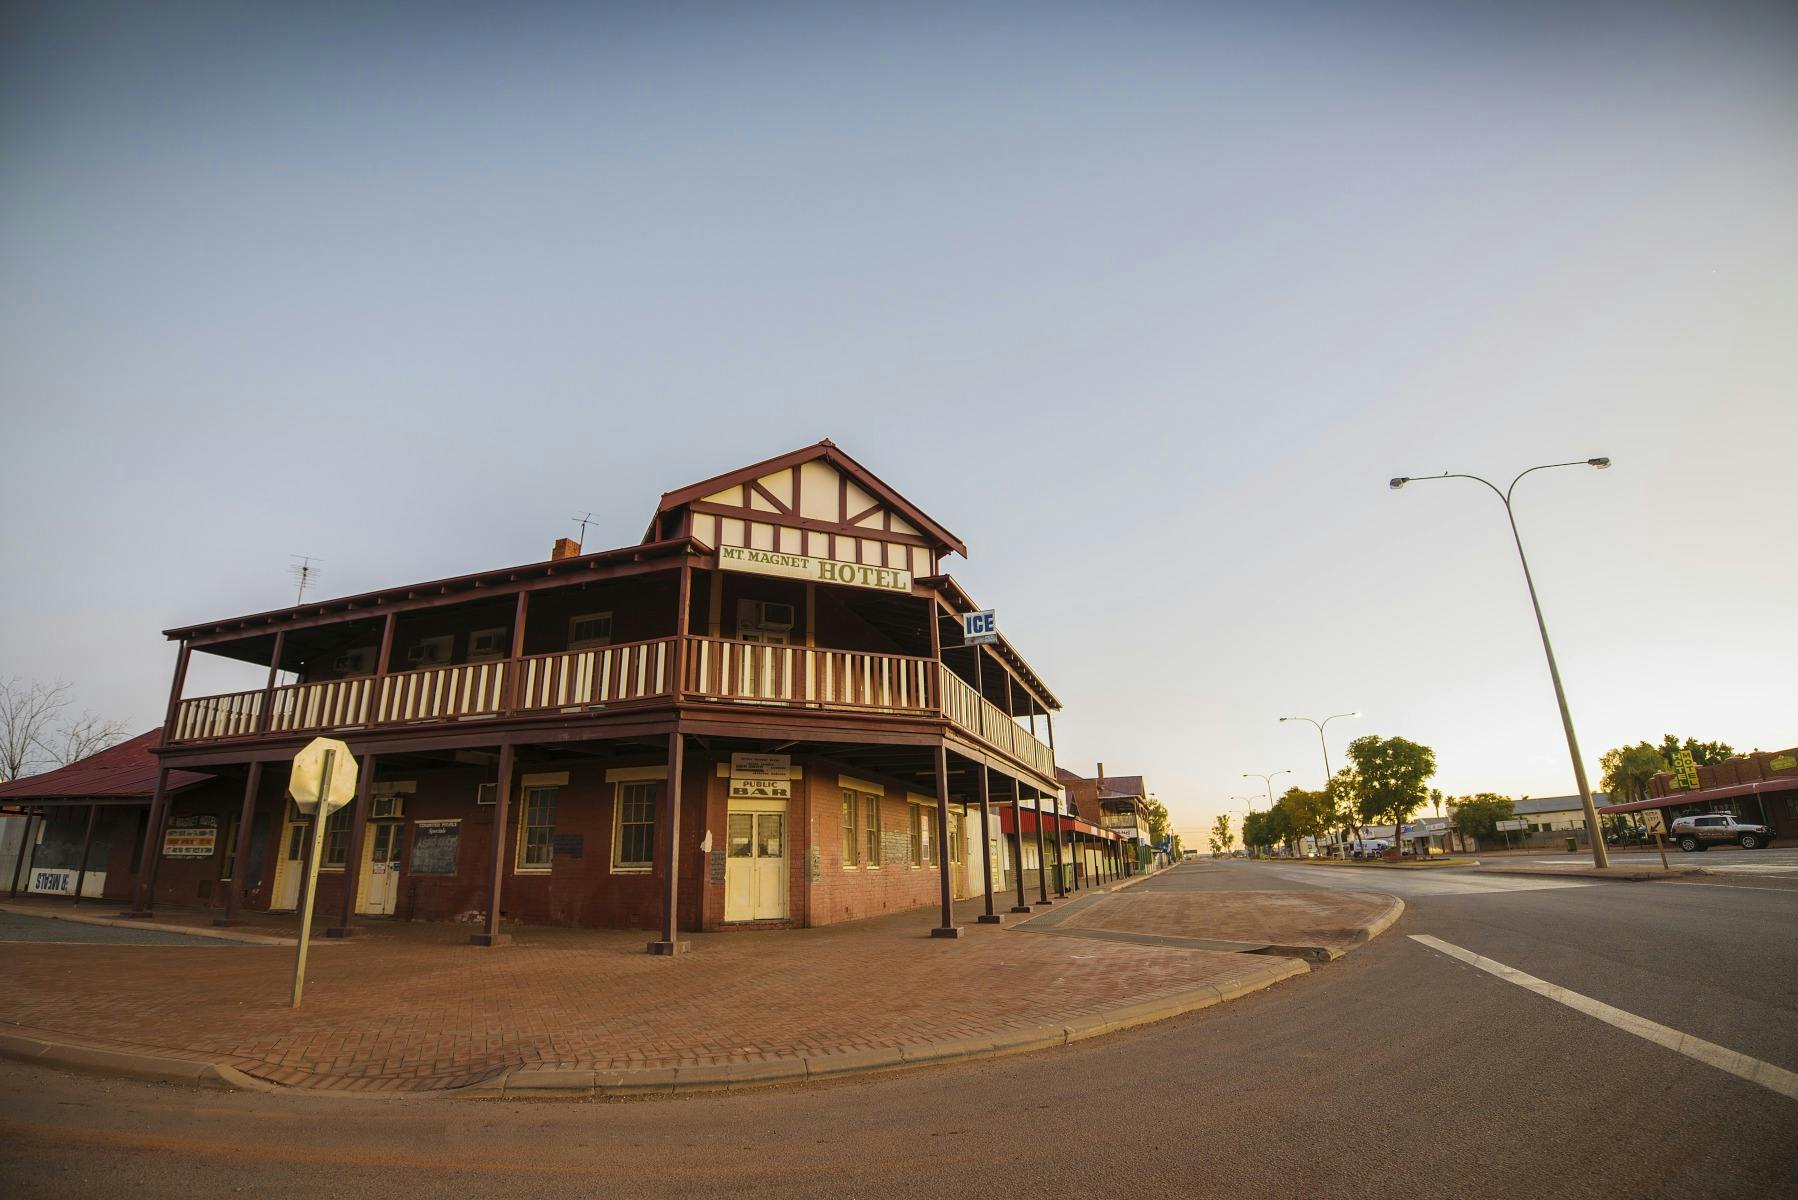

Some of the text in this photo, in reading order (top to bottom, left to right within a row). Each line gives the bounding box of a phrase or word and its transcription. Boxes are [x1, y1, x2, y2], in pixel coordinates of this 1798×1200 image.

[722, 547, 906, 590] MT. MAGNET HOTEL
[966, 613, 994, 635] ICE
[1672, 753, 1688, 787] HOTEL
[1682, 752, 1698, 786] MOTEL
[733, 788, 788, 797] BAR
[36, 873, 61, 890] MEALS
